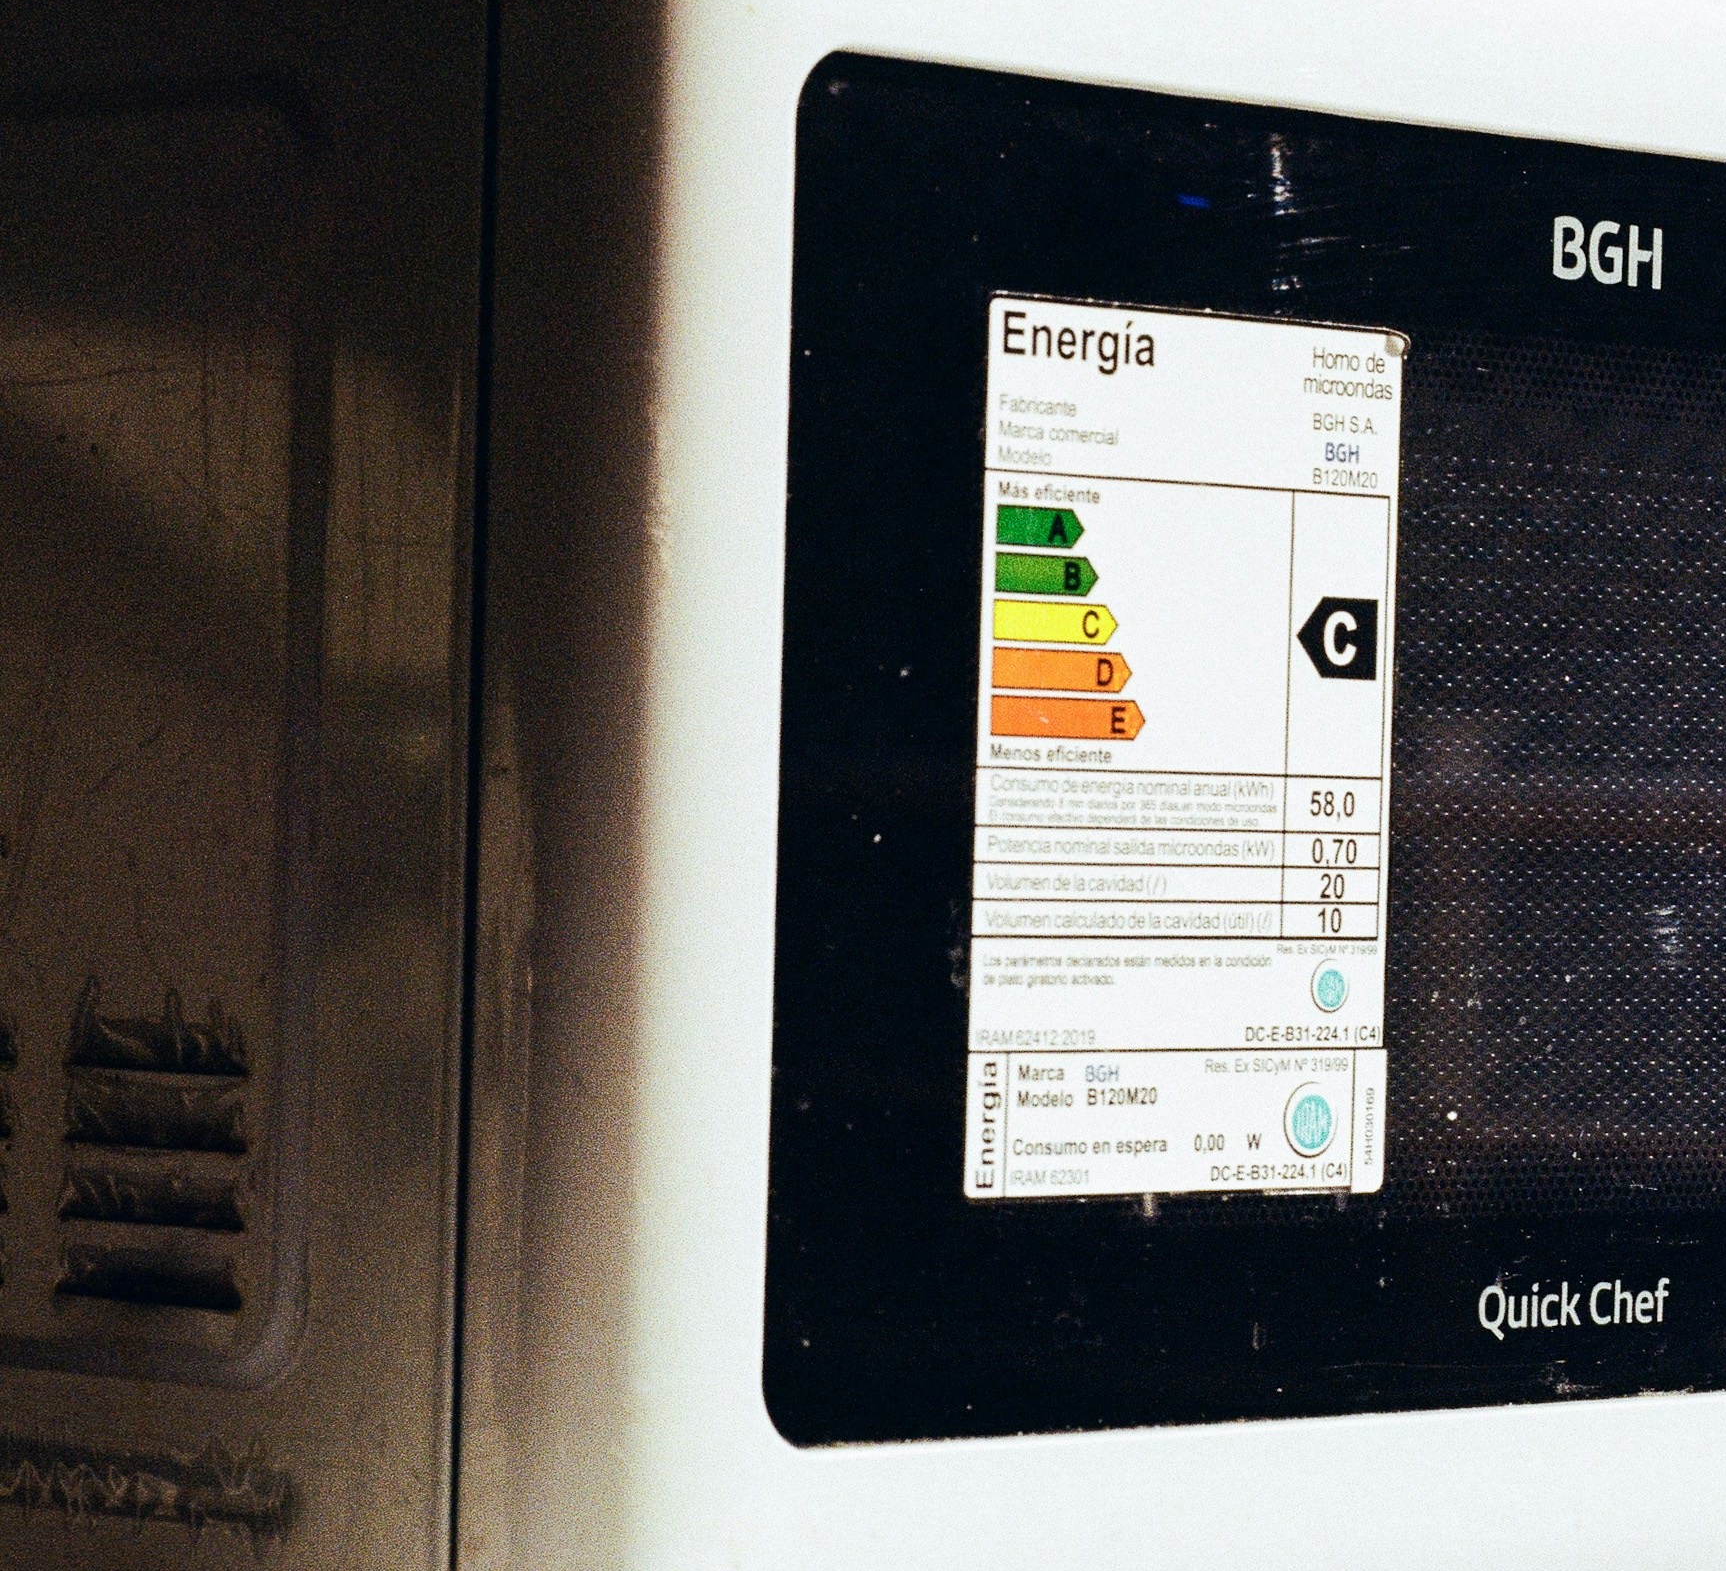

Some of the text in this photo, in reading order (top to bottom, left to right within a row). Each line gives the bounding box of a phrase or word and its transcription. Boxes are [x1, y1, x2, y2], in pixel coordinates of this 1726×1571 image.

[1553, 215, 1663, 290] BGH
[1002, 311, 1155, 374] Energía
[1366, 352, 1385, 373] de
[1304, 374, 1392, 400] microondas
[999, 393, 1077, 417] Fabricante
[999, 420, 1119, 445] Marca comercial
[1313, 413, 1377, 434] BGH S.A.
[998, 445, 1052, 466] Modelo
[1325, 441, 1360, 464] BGH
[1313, 468, 1378, 488] B120M20
[998, 481, 1101, 505] Más eficiente
[1047, 514, 1068, 543] A
[1064, 562, 1081, 590] B
[1082, 611, 1100, 639] C
[1323, 610, 1358, 667] C
[1097, 659, 1114, 687] D
[1111, 706, 1127, 735] E
[991, 742, 1112, 765] Menos eficiente
[991, 773, 1059, 794] Consumo
[1063, 779, 1079, 794] de
[1137, 780, 1190, 797] nominal
[1194, 781, 1231, 797] anual
[1233, 781, 1275, 800] (kWh)
[1310, 791, 1355, 822] 58,0
[987, 835, 1275, 861] Potencia nominal salida microondas (kW)
[1312, 838, 1357, 867] 0,70
[987, 873, 1049, 891] Volumen
[1053, 874, 1071, 891] de
[1073, 875, 1085, 891] la
[1088, 875, 1144, 892] cavidad
[1320, 873, 1345, 899] 20
[985, 911, 1050, 929] Volumen
[1053, 911, 1125, 929] calculado
[1128, 912, 1145, 929] de
[1148, 913, 1161, 929] la
[1164, 913, 1220, 930] cavidad
[1318, 908, 1342, 933] 10
[1154, 955, 1196, 968] medidos
[1199, 957, 1211, 968] en
[1354, 1025, 1381, 1044] (C4)
[1018, 1064, 1120, 1082] Marca BGH
[1204, 1059, 1230, 1073] Res.
[1234, 1058, 1249, 1073] Ex
[1018, 1087, 1157, 1107] Modelo B120M20
[975, 1062, 1001, 1189] Energía
[1013, 1139, 1088, 1156] Consumo
[1093, 1142, 1110, 1154] en
[1116, 1139, 1168, 1157] espera
[1247, 1133, 1262, 1150] W
[1322, 1163, 1348, 1181] (C4)
[1478, 1277, 1670, 1341] Quick Chef
